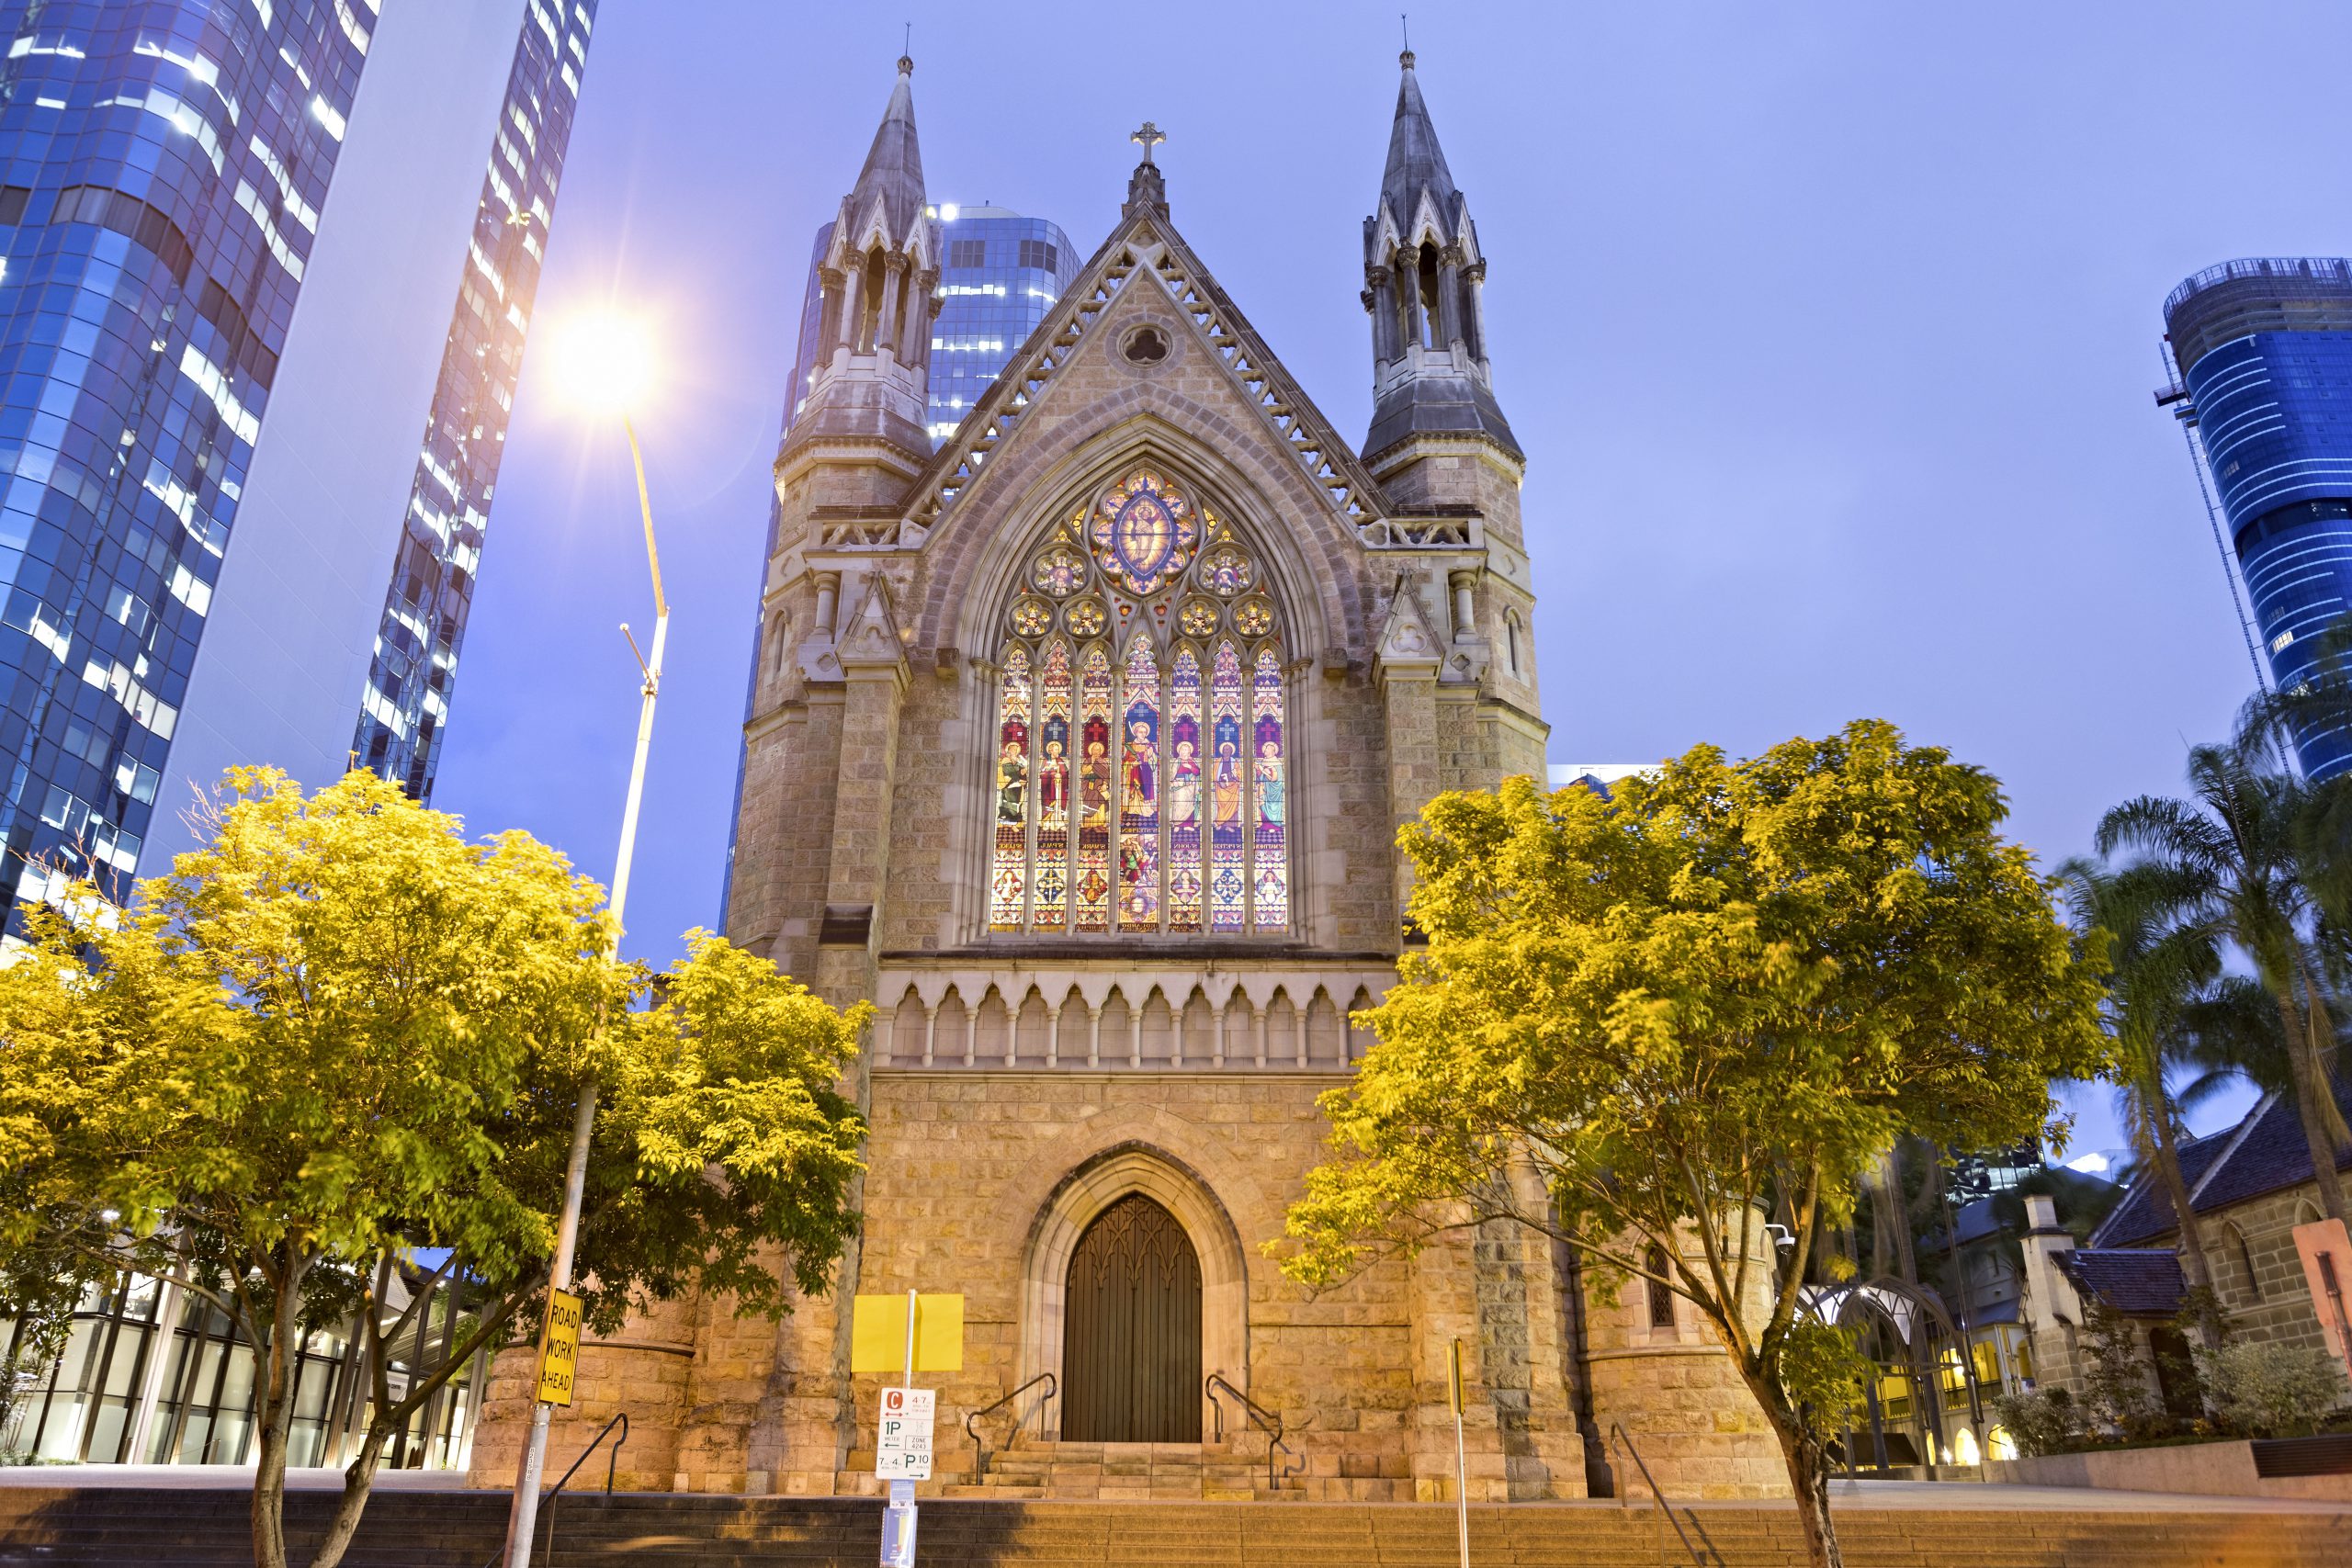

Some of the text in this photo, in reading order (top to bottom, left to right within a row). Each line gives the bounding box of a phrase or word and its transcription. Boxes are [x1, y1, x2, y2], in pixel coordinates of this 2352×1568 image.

[551, 1304, 577, 1329] ROAD
[547, 1337, 573, 1360] WORK
[542, 1371, 570, 1391] AHEAD
[890, 1392, 899, 1409] C
[886, 1421, 901, 1435] 1P
[905, 1454, 929, 1469] P 10
